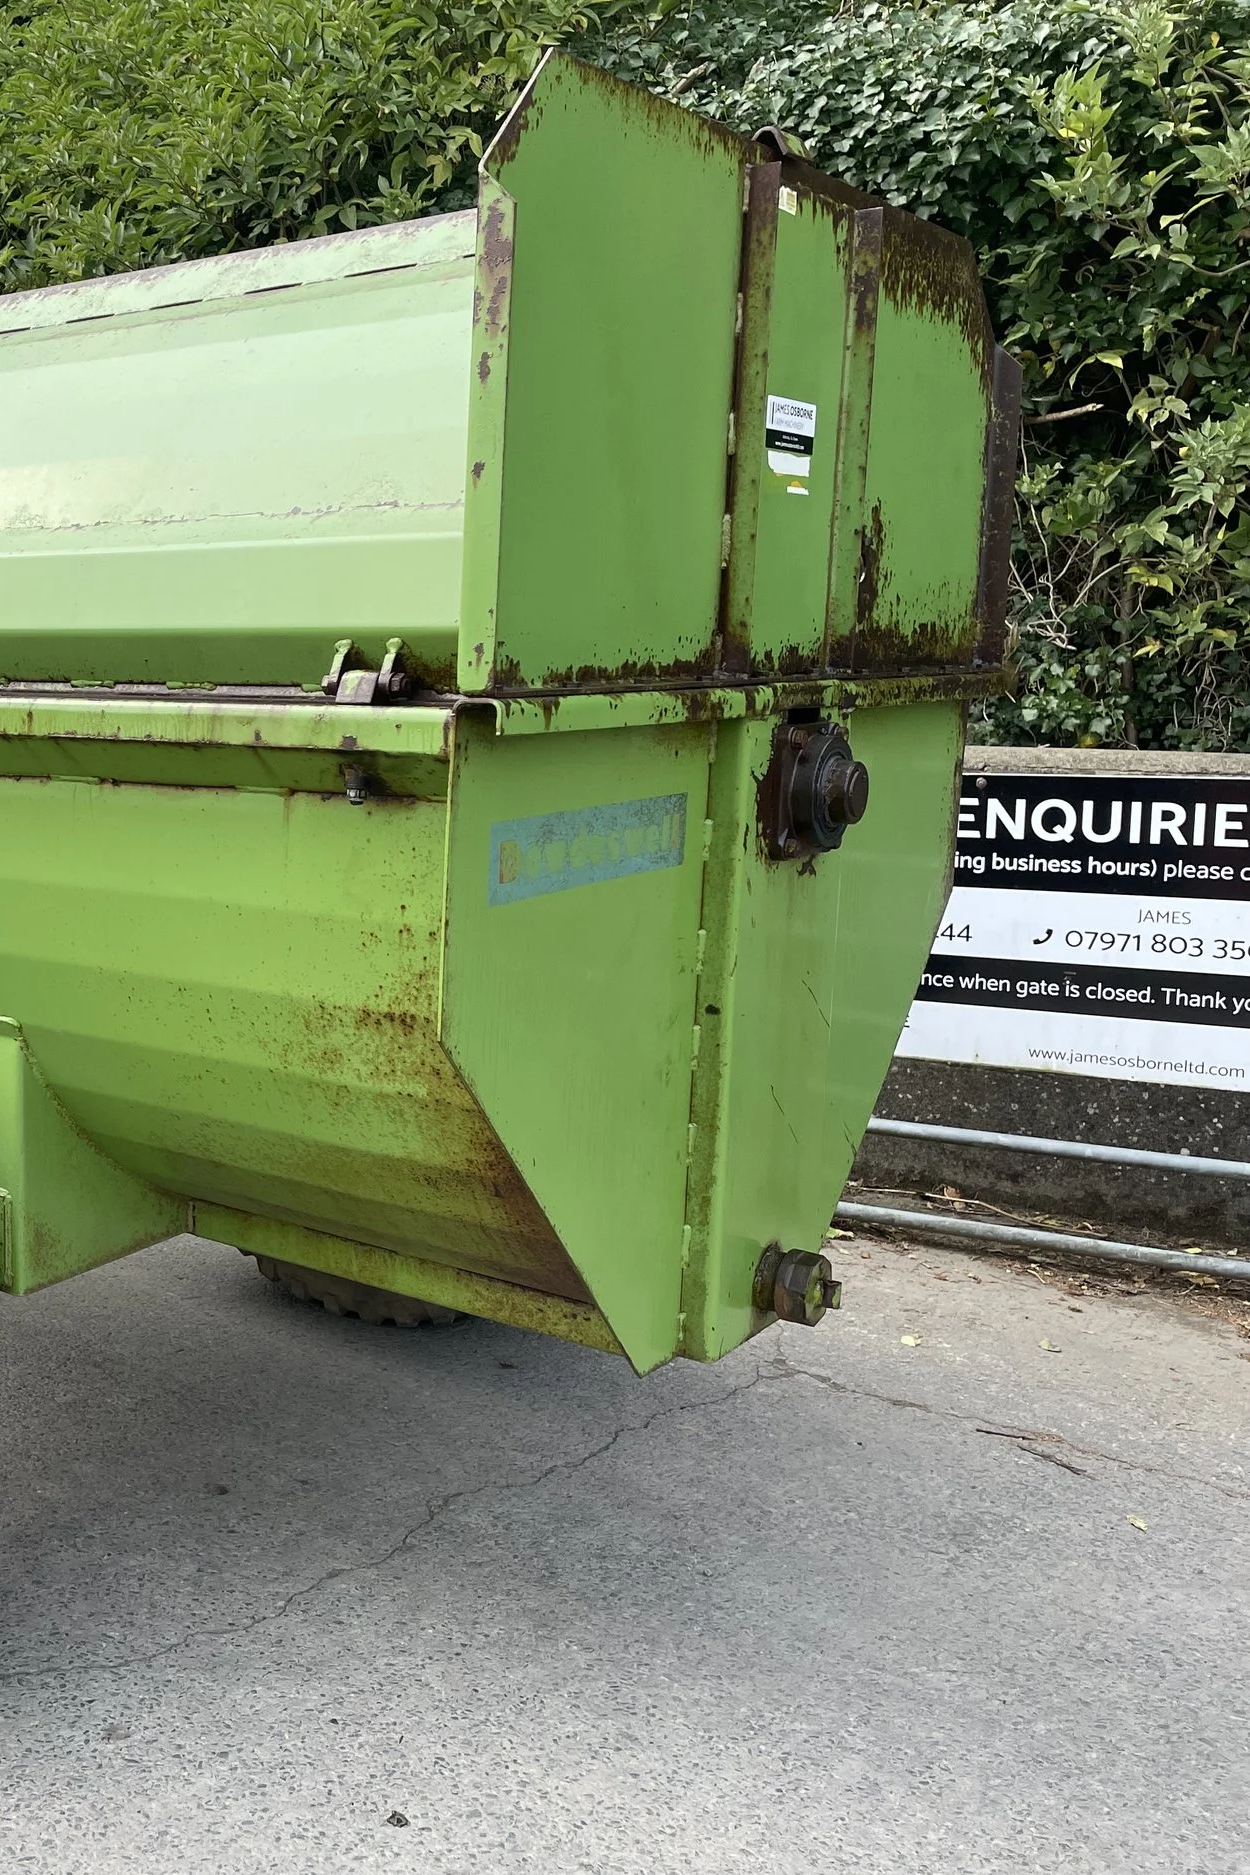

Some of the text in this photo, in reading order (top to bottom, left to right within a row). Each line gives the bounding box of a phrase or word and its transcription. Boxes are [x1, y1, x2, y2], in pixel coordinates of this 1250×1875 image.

[775, 402, 814, 420] JAMES OSBORNE
[991, 852, 1082, 874] business
[1087, 855, 1157, 878] hours)
[1163, 860, 1234, 882] please
[1137, 908, 1192, 925] JAMES
[935, 923, 973, 943] 44
[1064, 929, 1250, 961] 07971 803 35
[958, 972, 1011, 993] when
[1015, 976, 1061, 999] gate
[1064, 979, 1081, 998] is
[1085, 983, 1156, 1004] closed.
[1160, 986, 1228, 1010] Thank
[1028, 1047, 1246, 1079] www.jamesosborneltd.com
